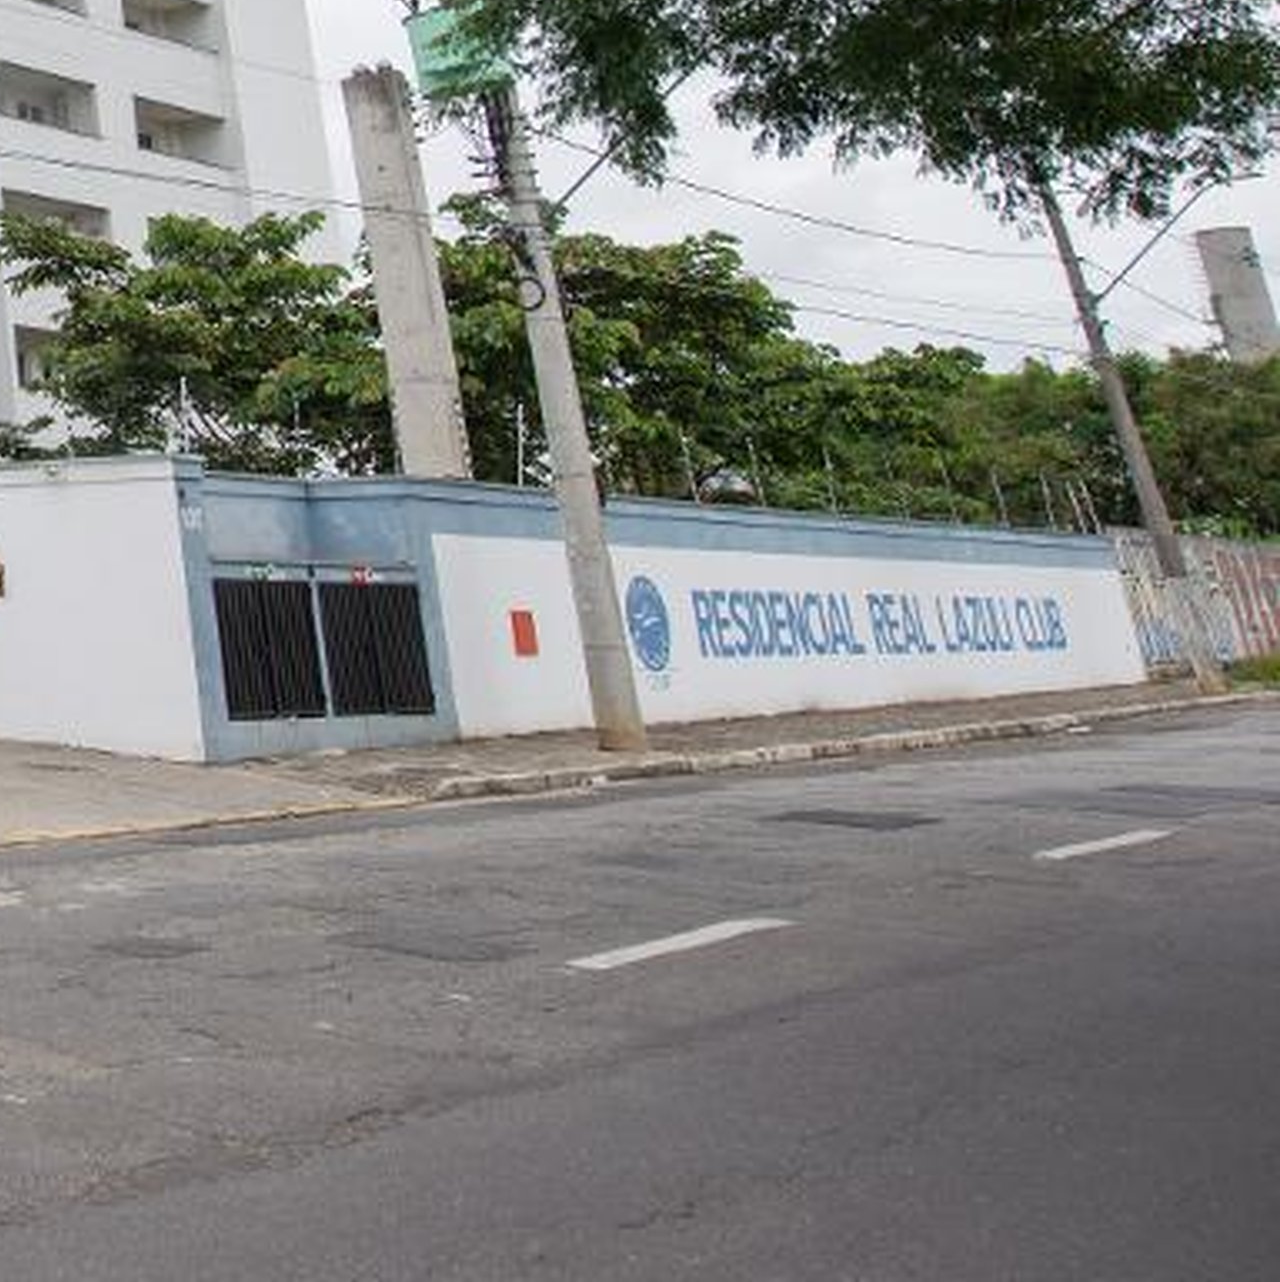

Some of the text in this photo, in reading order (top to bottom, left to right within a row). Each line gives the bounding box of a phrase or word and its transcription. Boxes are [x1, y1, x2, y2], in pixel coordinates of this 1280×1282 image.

[691, 589, 1069, 658] RESIDENCIAL REAL LAZULI CLUB
